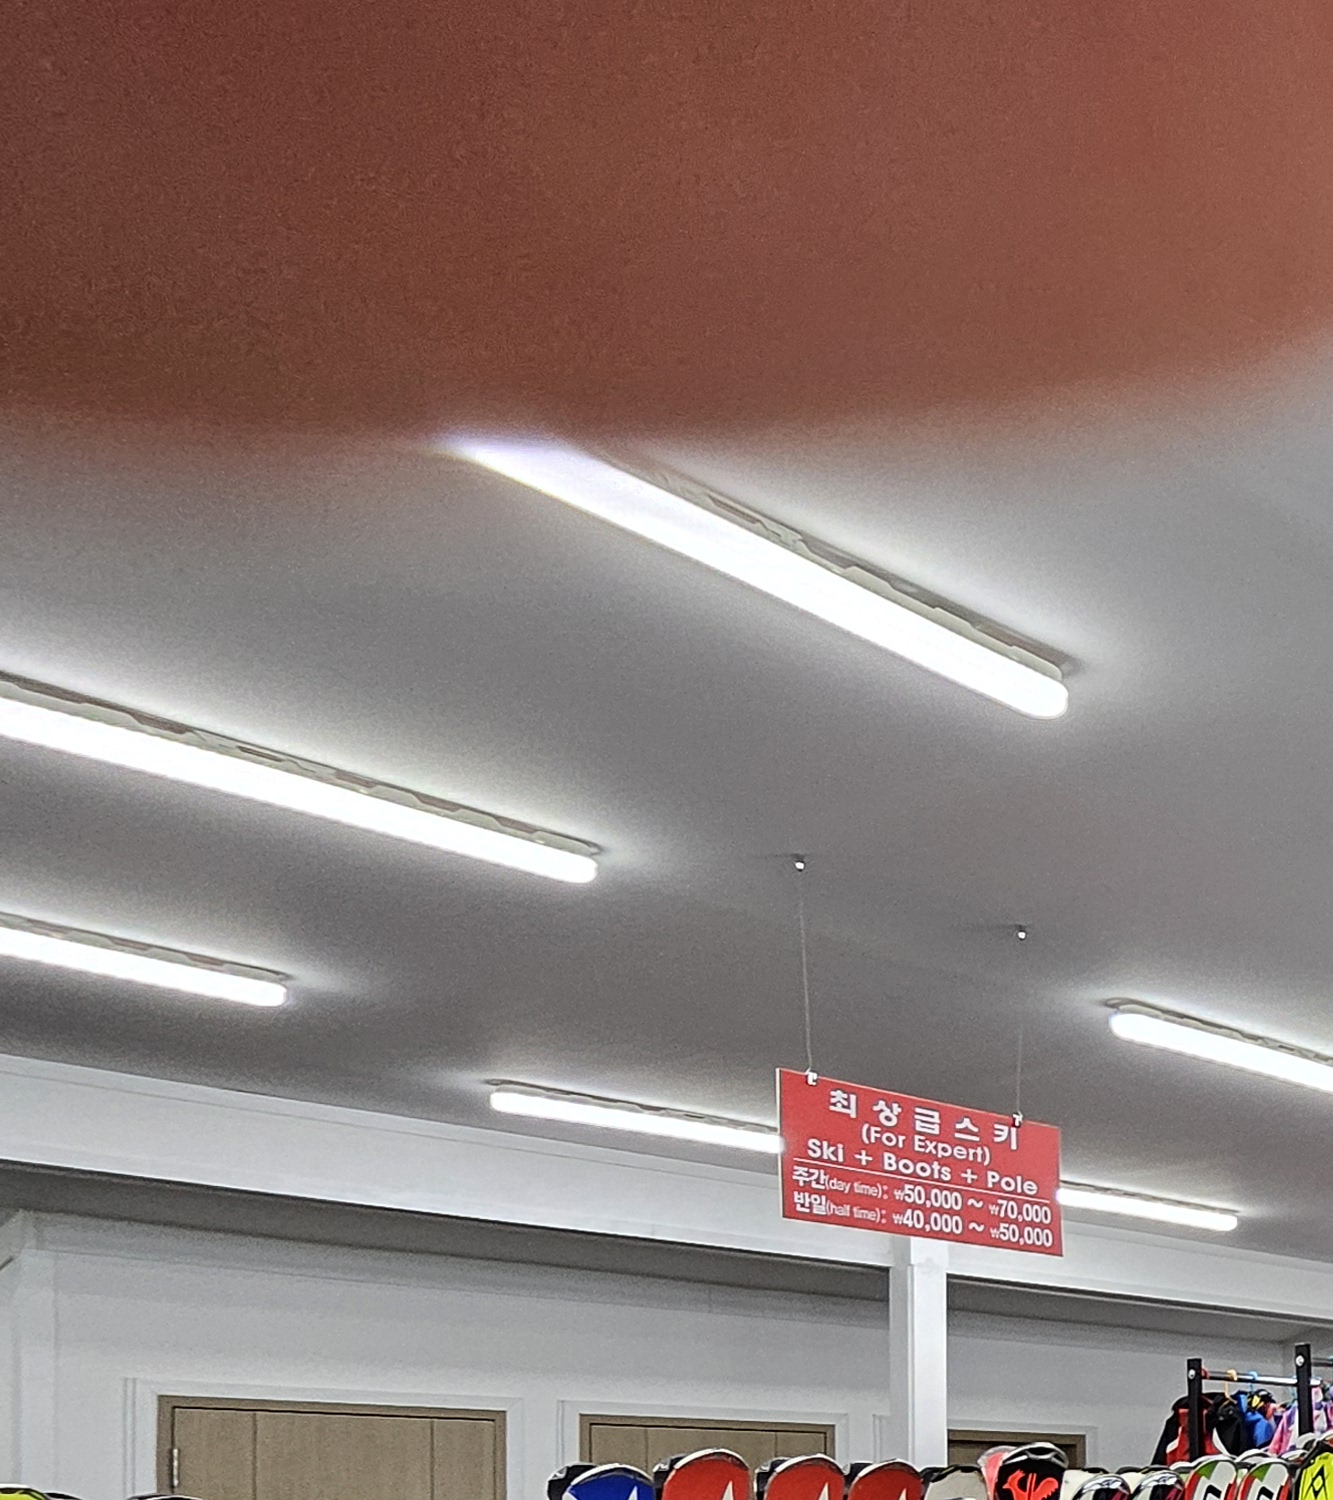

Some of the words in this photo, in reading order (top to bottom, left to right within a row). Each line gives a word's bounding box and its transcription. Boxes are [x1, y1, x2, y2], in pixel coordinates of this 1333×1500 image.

[861, 1123, 905, 1148] (For
[914, 1136, 991, 1166] Expert)
[792, 1165, 850, 1194] 주간(day
[807, 1139, 844, 1162] Ski
[883, 1152, 951, 1181] Boots
[987, 1171, 1038, 1195] Pole
[793, 1190, 850, 1218] 반일(half
